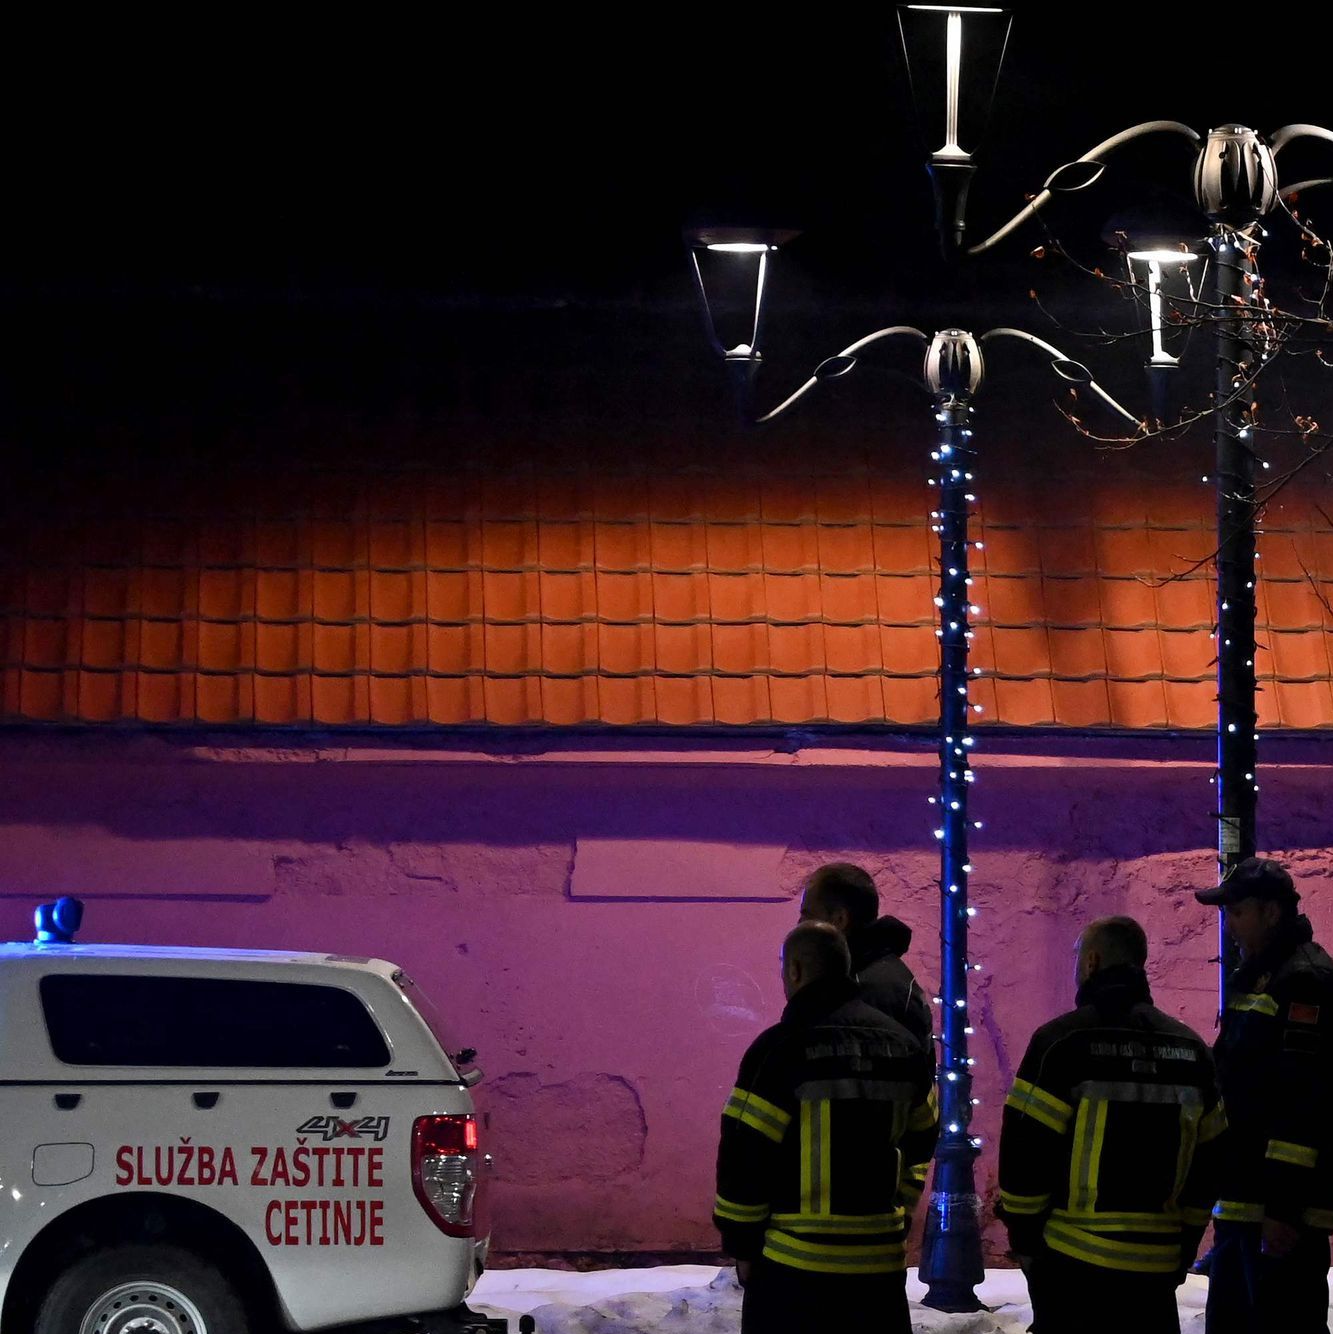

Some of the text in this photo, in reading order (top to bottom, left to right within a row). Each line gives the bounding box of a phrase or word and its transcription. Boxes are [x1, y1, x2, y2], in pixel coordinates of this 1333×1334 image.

[115, 1137, 384, 1187] SLUŽBA ZAŠTITE
[265, 1200, 384, 1246] CETINJE
